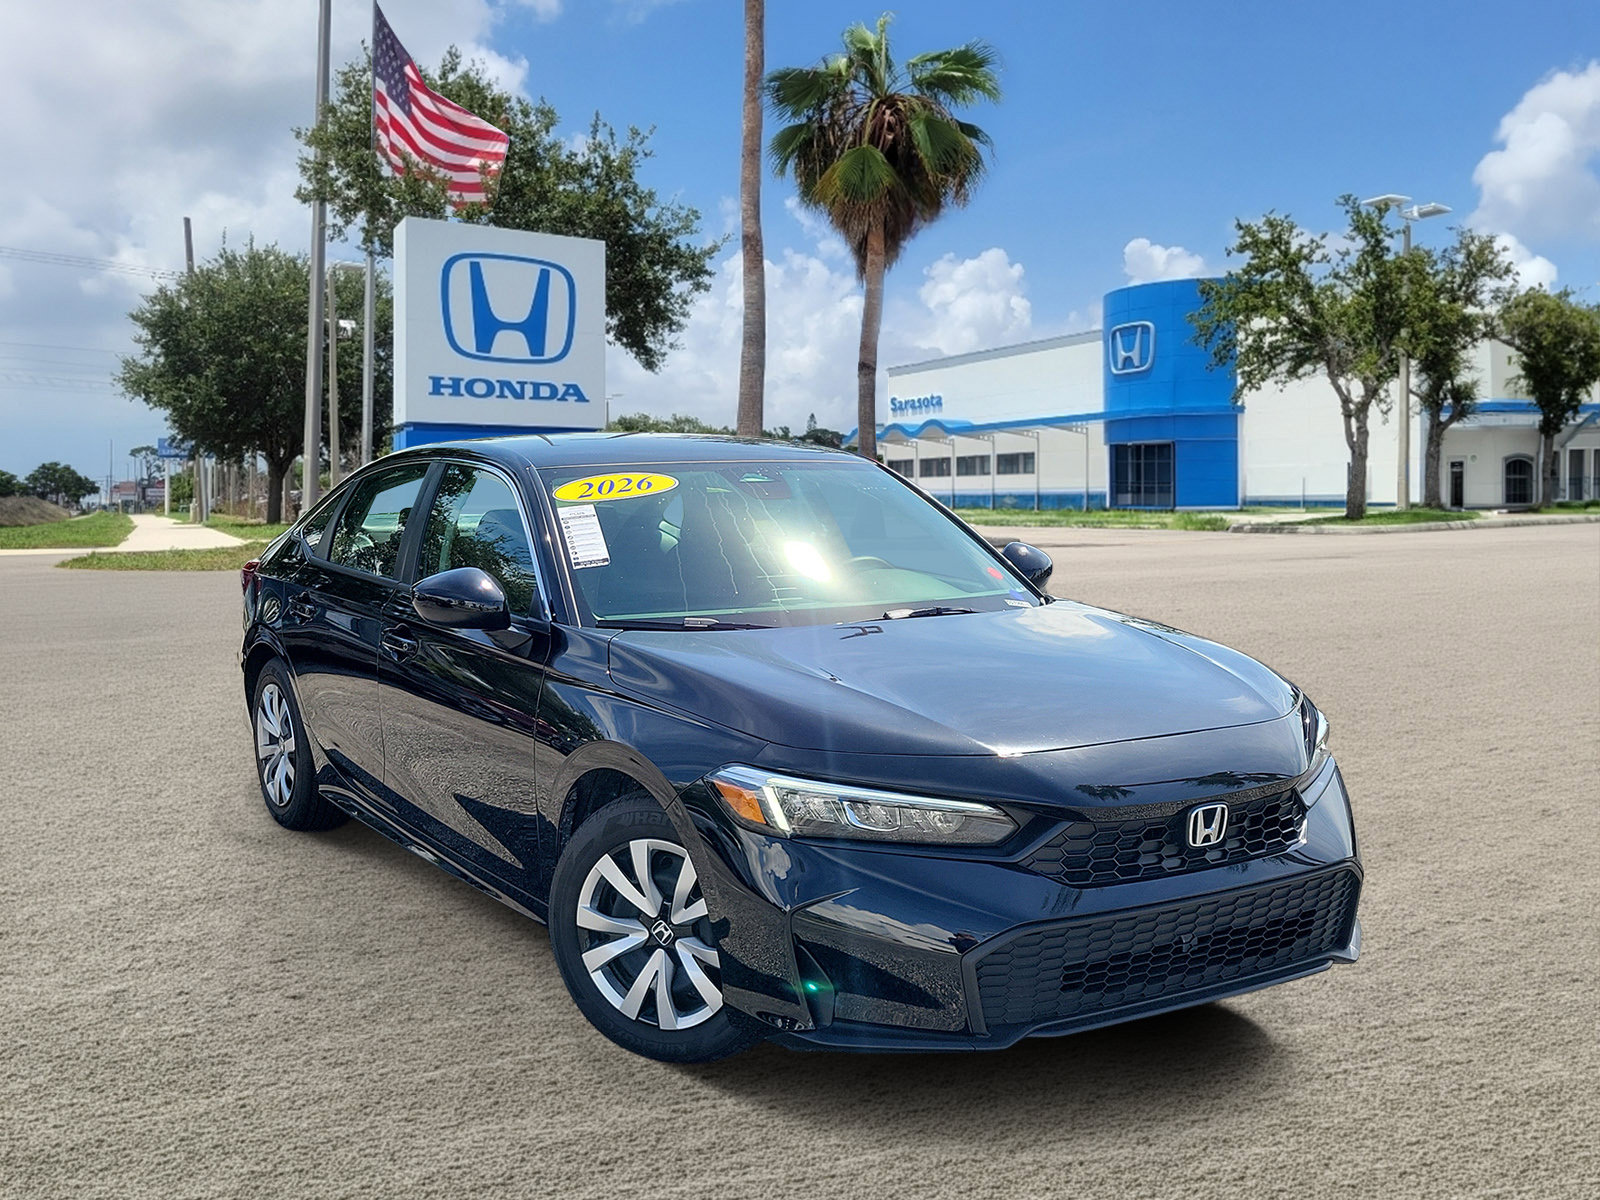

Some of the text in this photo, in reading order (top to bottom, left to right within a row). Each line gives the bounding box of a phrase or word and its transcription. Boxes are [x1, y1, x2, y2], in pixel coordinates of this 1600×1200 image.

[428, 376, 590, 403] HONDA
[890, 394, 943, 412] Sarasota
[577, 476, 654, 499] 2026
